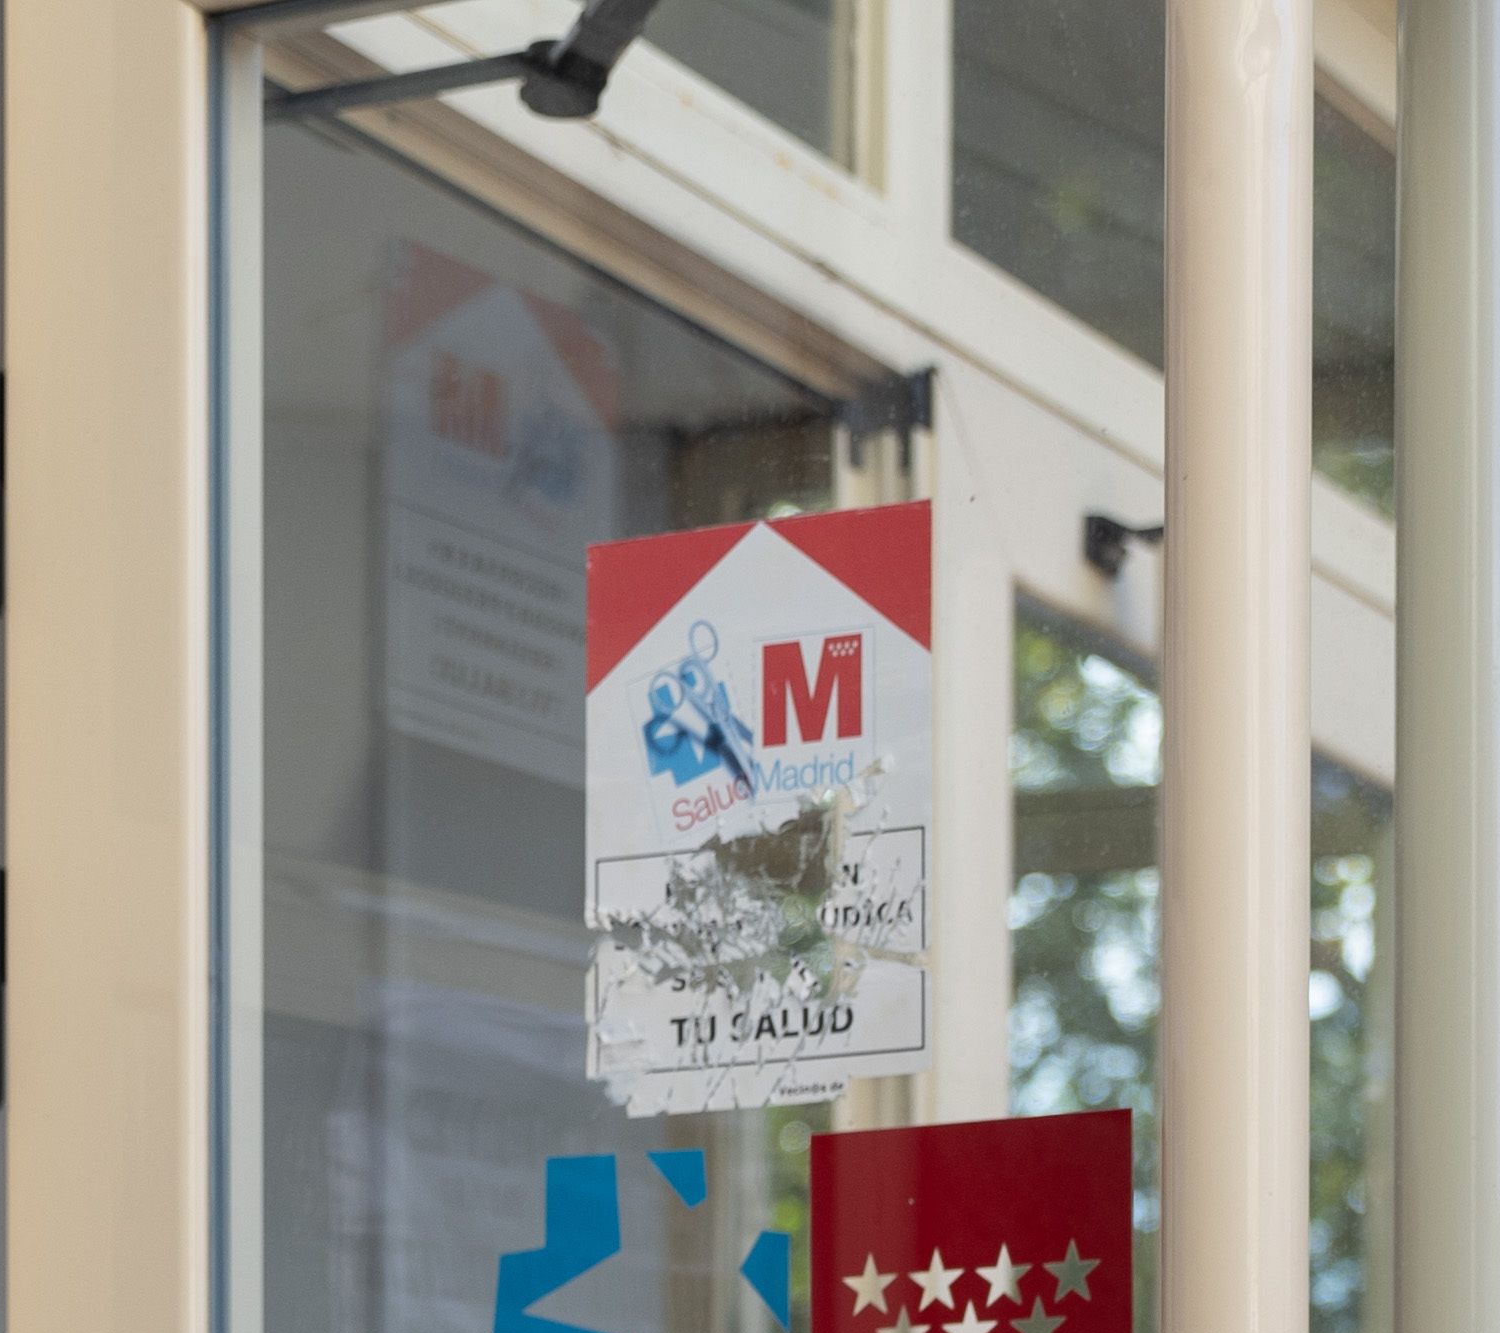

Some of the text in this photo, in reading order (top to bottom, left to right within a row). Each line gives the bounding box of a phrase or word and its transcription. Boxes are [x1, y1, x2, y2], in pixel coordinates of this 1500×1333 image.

[762, 633, 862, 747] M
[670, 1004, 854, 1047] TU SALUD
